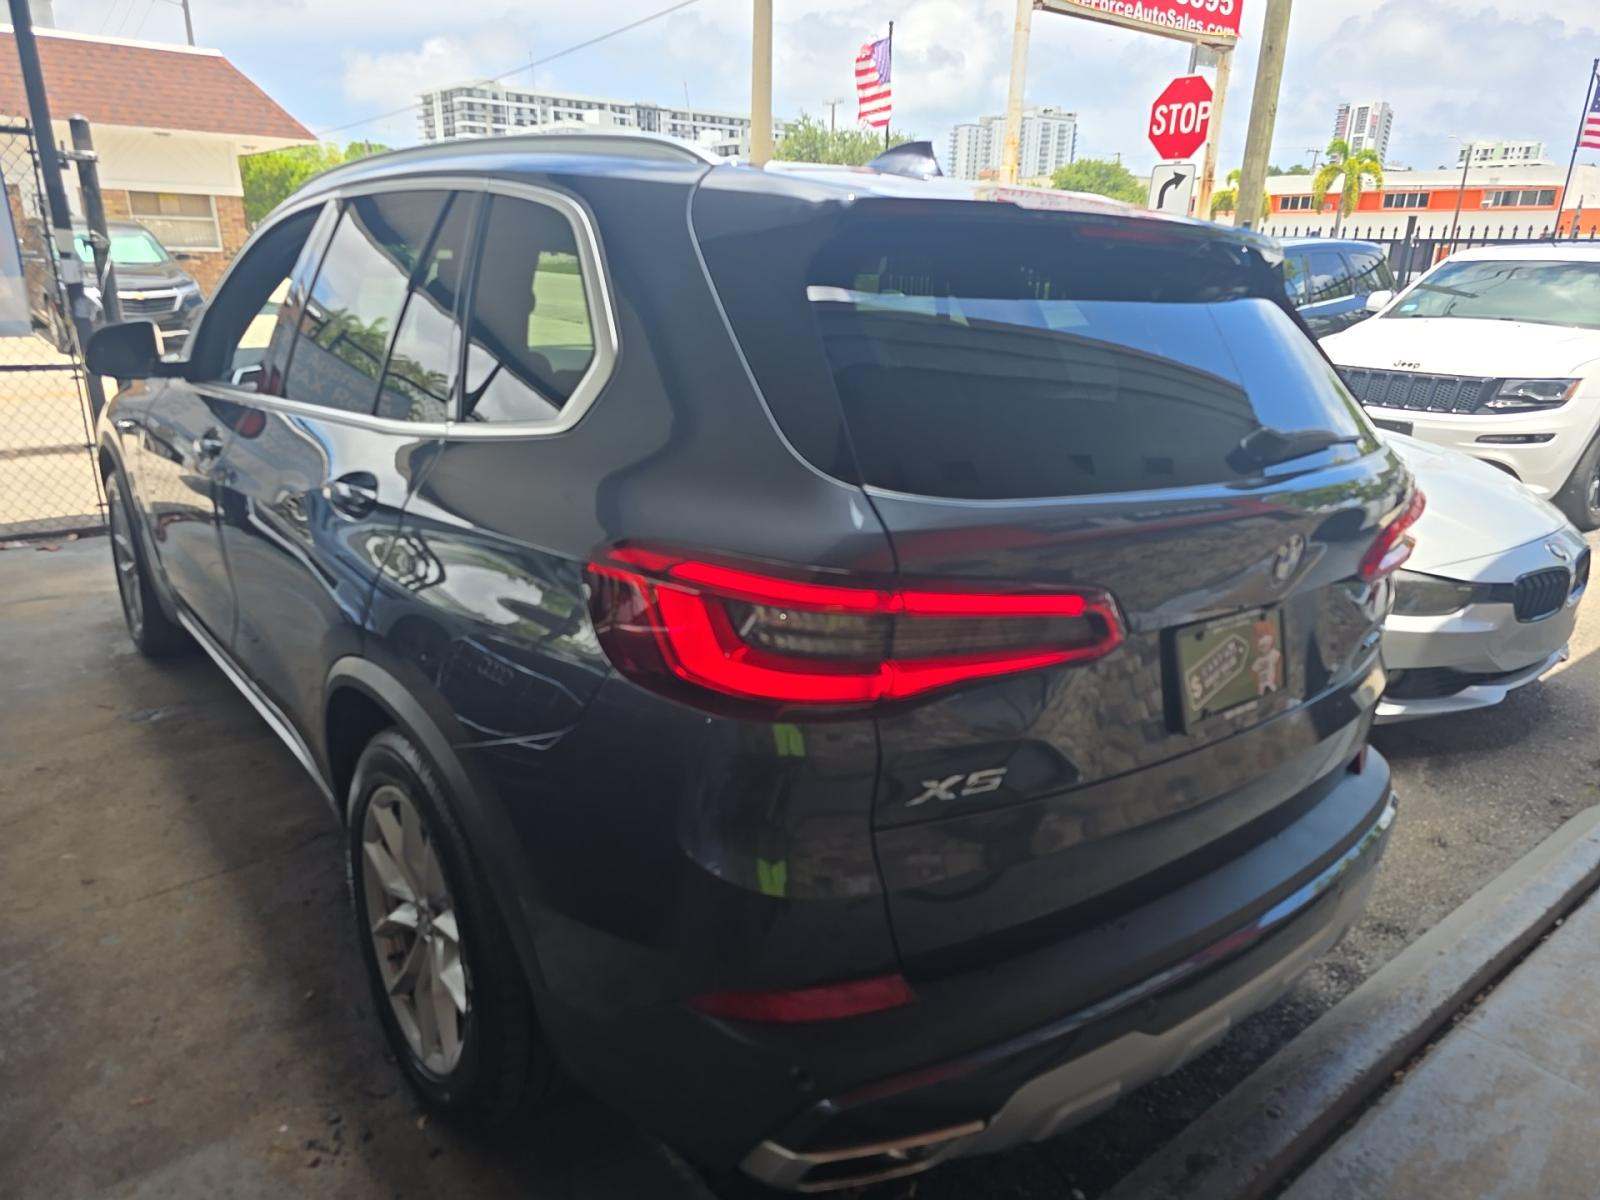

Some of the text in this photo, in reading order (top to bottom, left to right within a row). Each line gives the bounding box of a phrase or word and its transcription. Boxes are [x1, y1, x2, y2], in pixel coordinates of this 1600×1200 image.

[1151, 100, 1211, 136] STOP
[1393, 360, 1421, 370] Jeep
[904, 766, 1008, 807] X5
